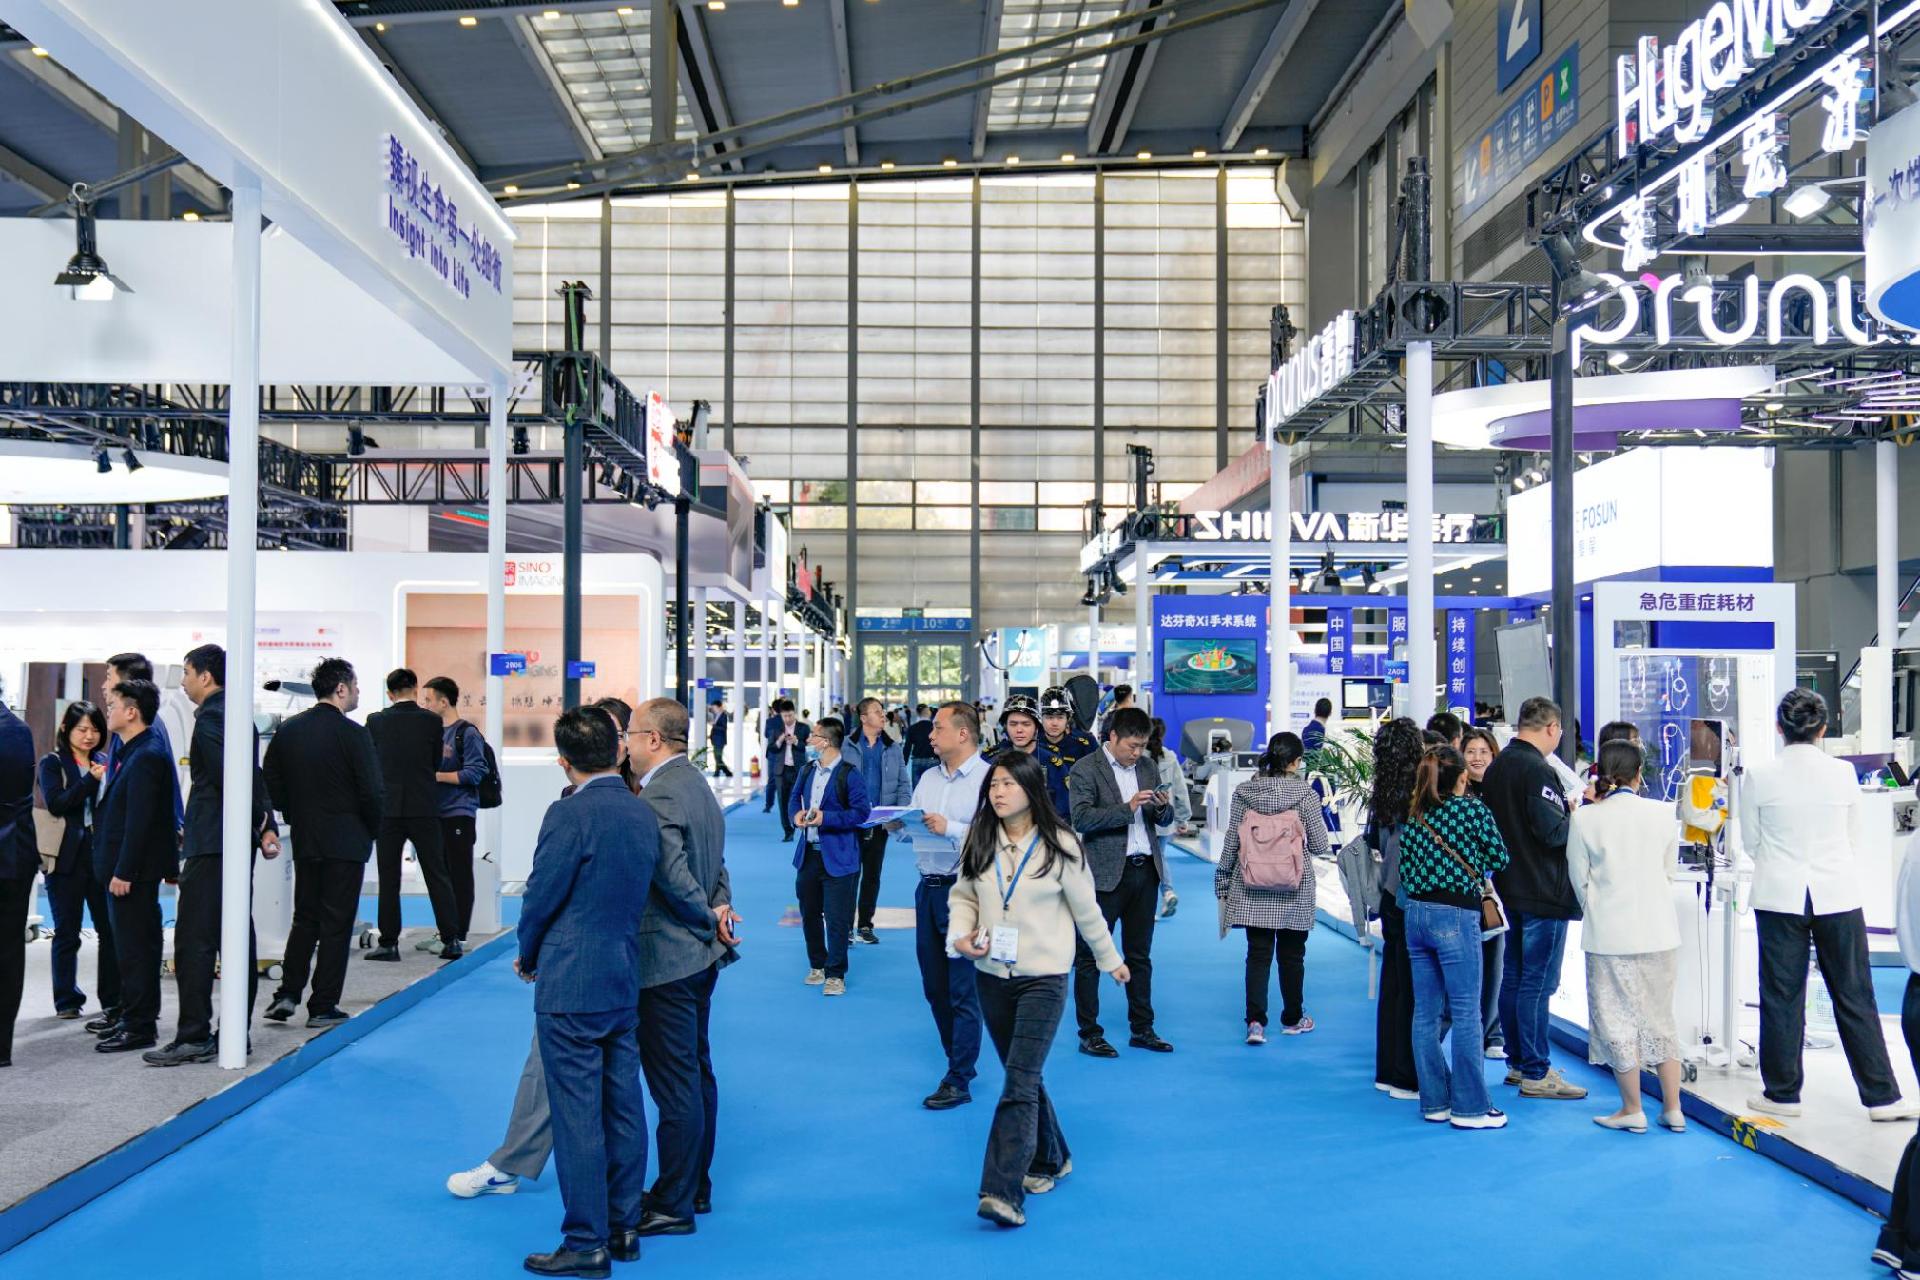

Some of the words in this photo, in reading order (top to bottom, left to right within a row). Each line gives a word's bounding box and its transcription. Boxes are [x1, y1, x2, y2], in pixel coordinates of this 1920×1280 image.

[390, 133, 502, 294] 臻视生命每一处细微
[389, 194, 425, 258] Insight
[430, 234, 449, 279] into
[1582, 500, 1617, 530] FOSUN
[518, 562, 551, 573] SINO
[518, 576, 565, 587] IMAGIN
[1639, 592, 1756, 612] 急危重症耗材
[1160, 614, 1257, 628] 达芬奇Xi手术系统
[1330, 616, 1345, 673] 中国智
[1451, 616, 1467, 694] 持续创新
